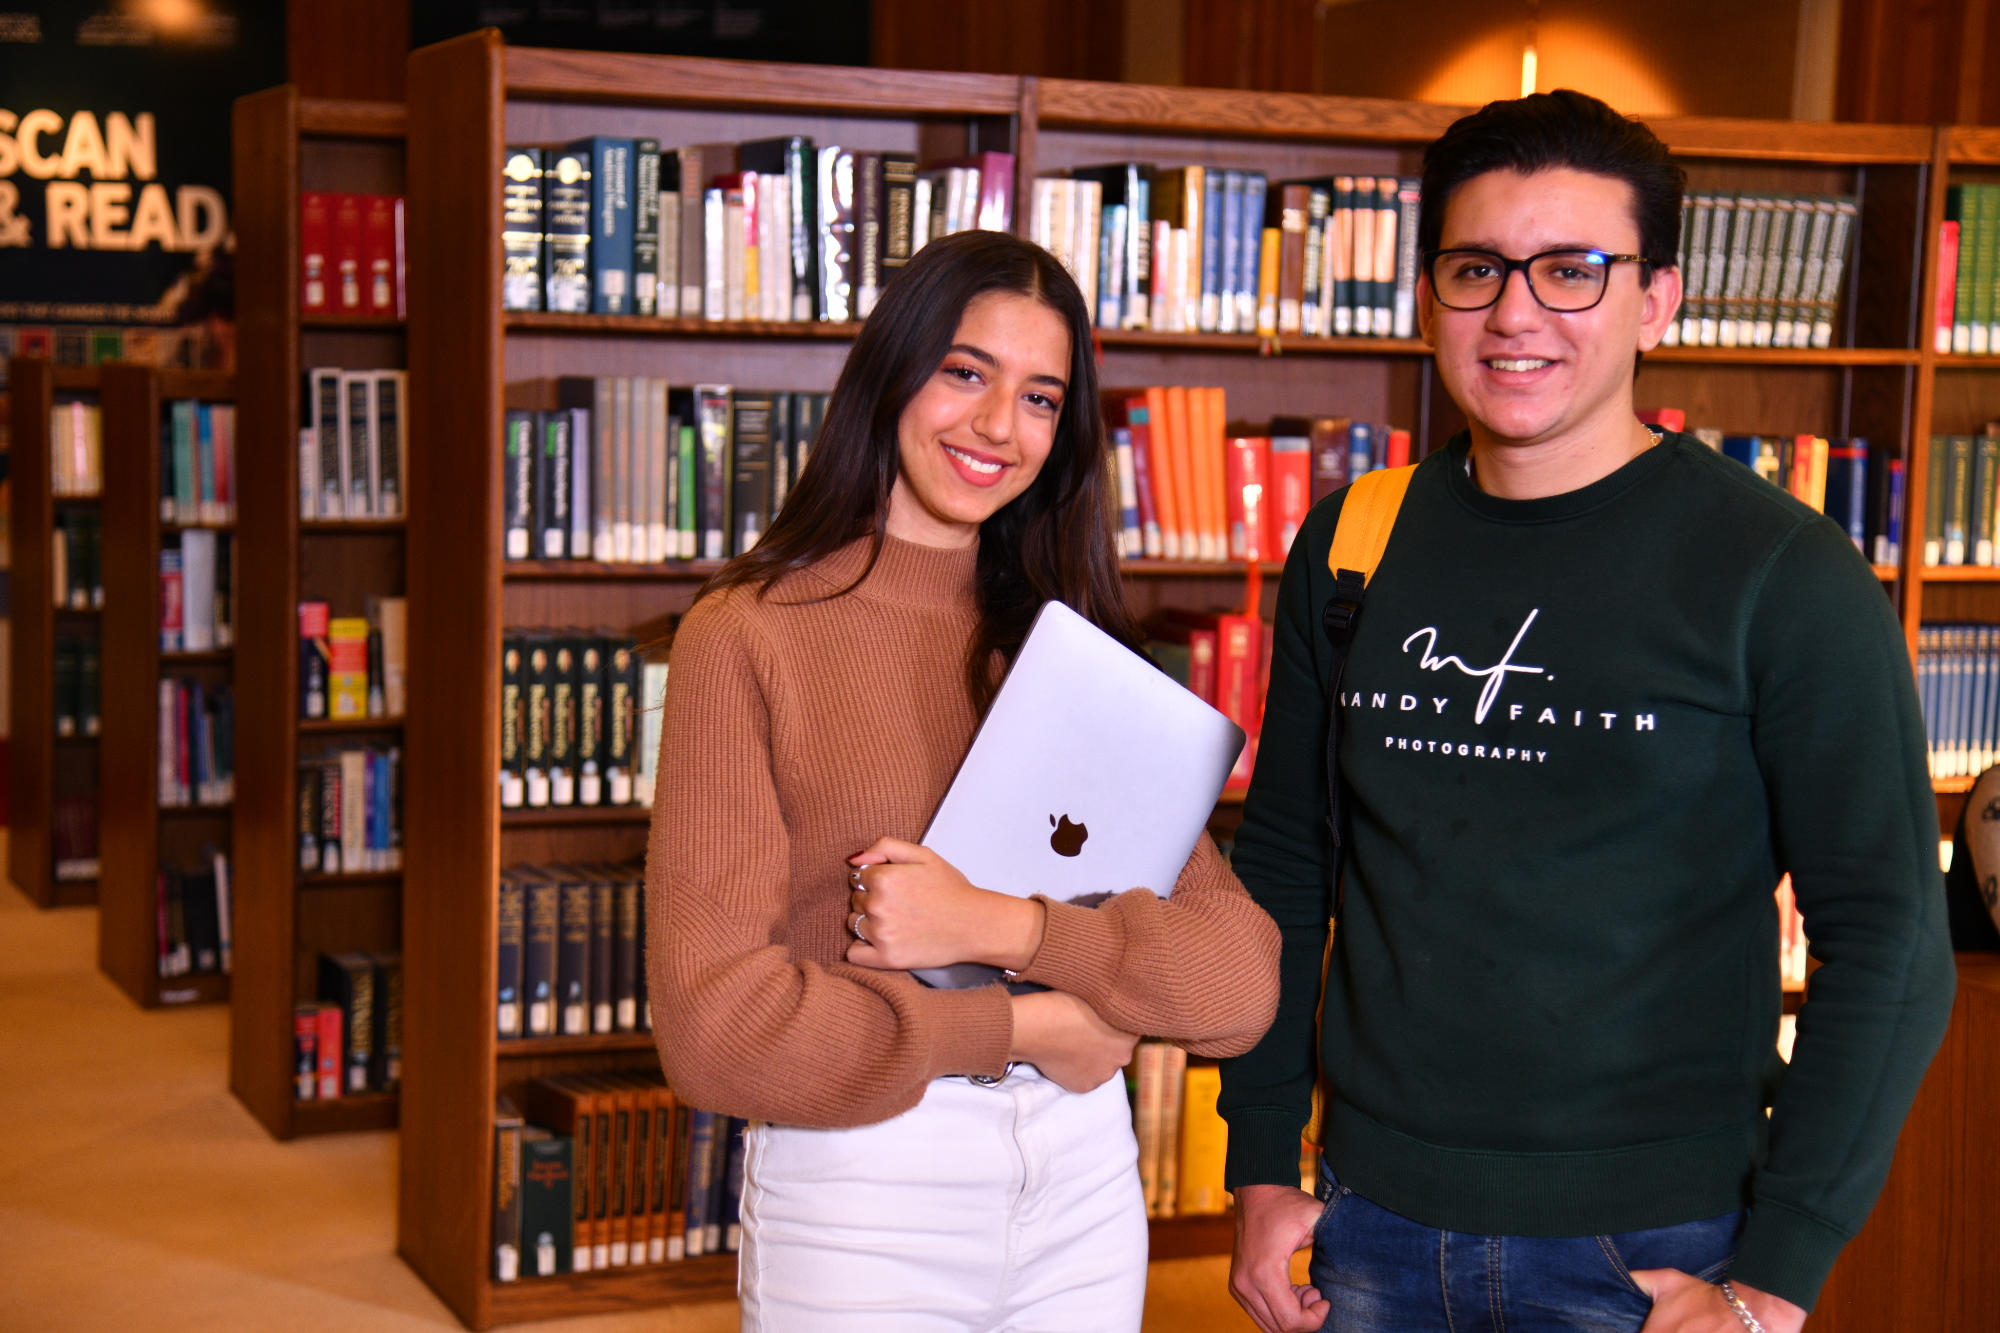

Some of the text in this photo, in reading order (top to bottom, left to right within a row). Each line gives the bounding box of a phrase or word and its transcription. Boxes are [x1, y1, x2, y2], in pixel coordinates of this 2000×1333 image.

[0, 109, 157, 180] SCAN
[45, 181, 237, 254] READ.
[1509, 704, 1656, 732] FAITH
[1385, 736, 1548, 763] PHOTOGRAPHY
